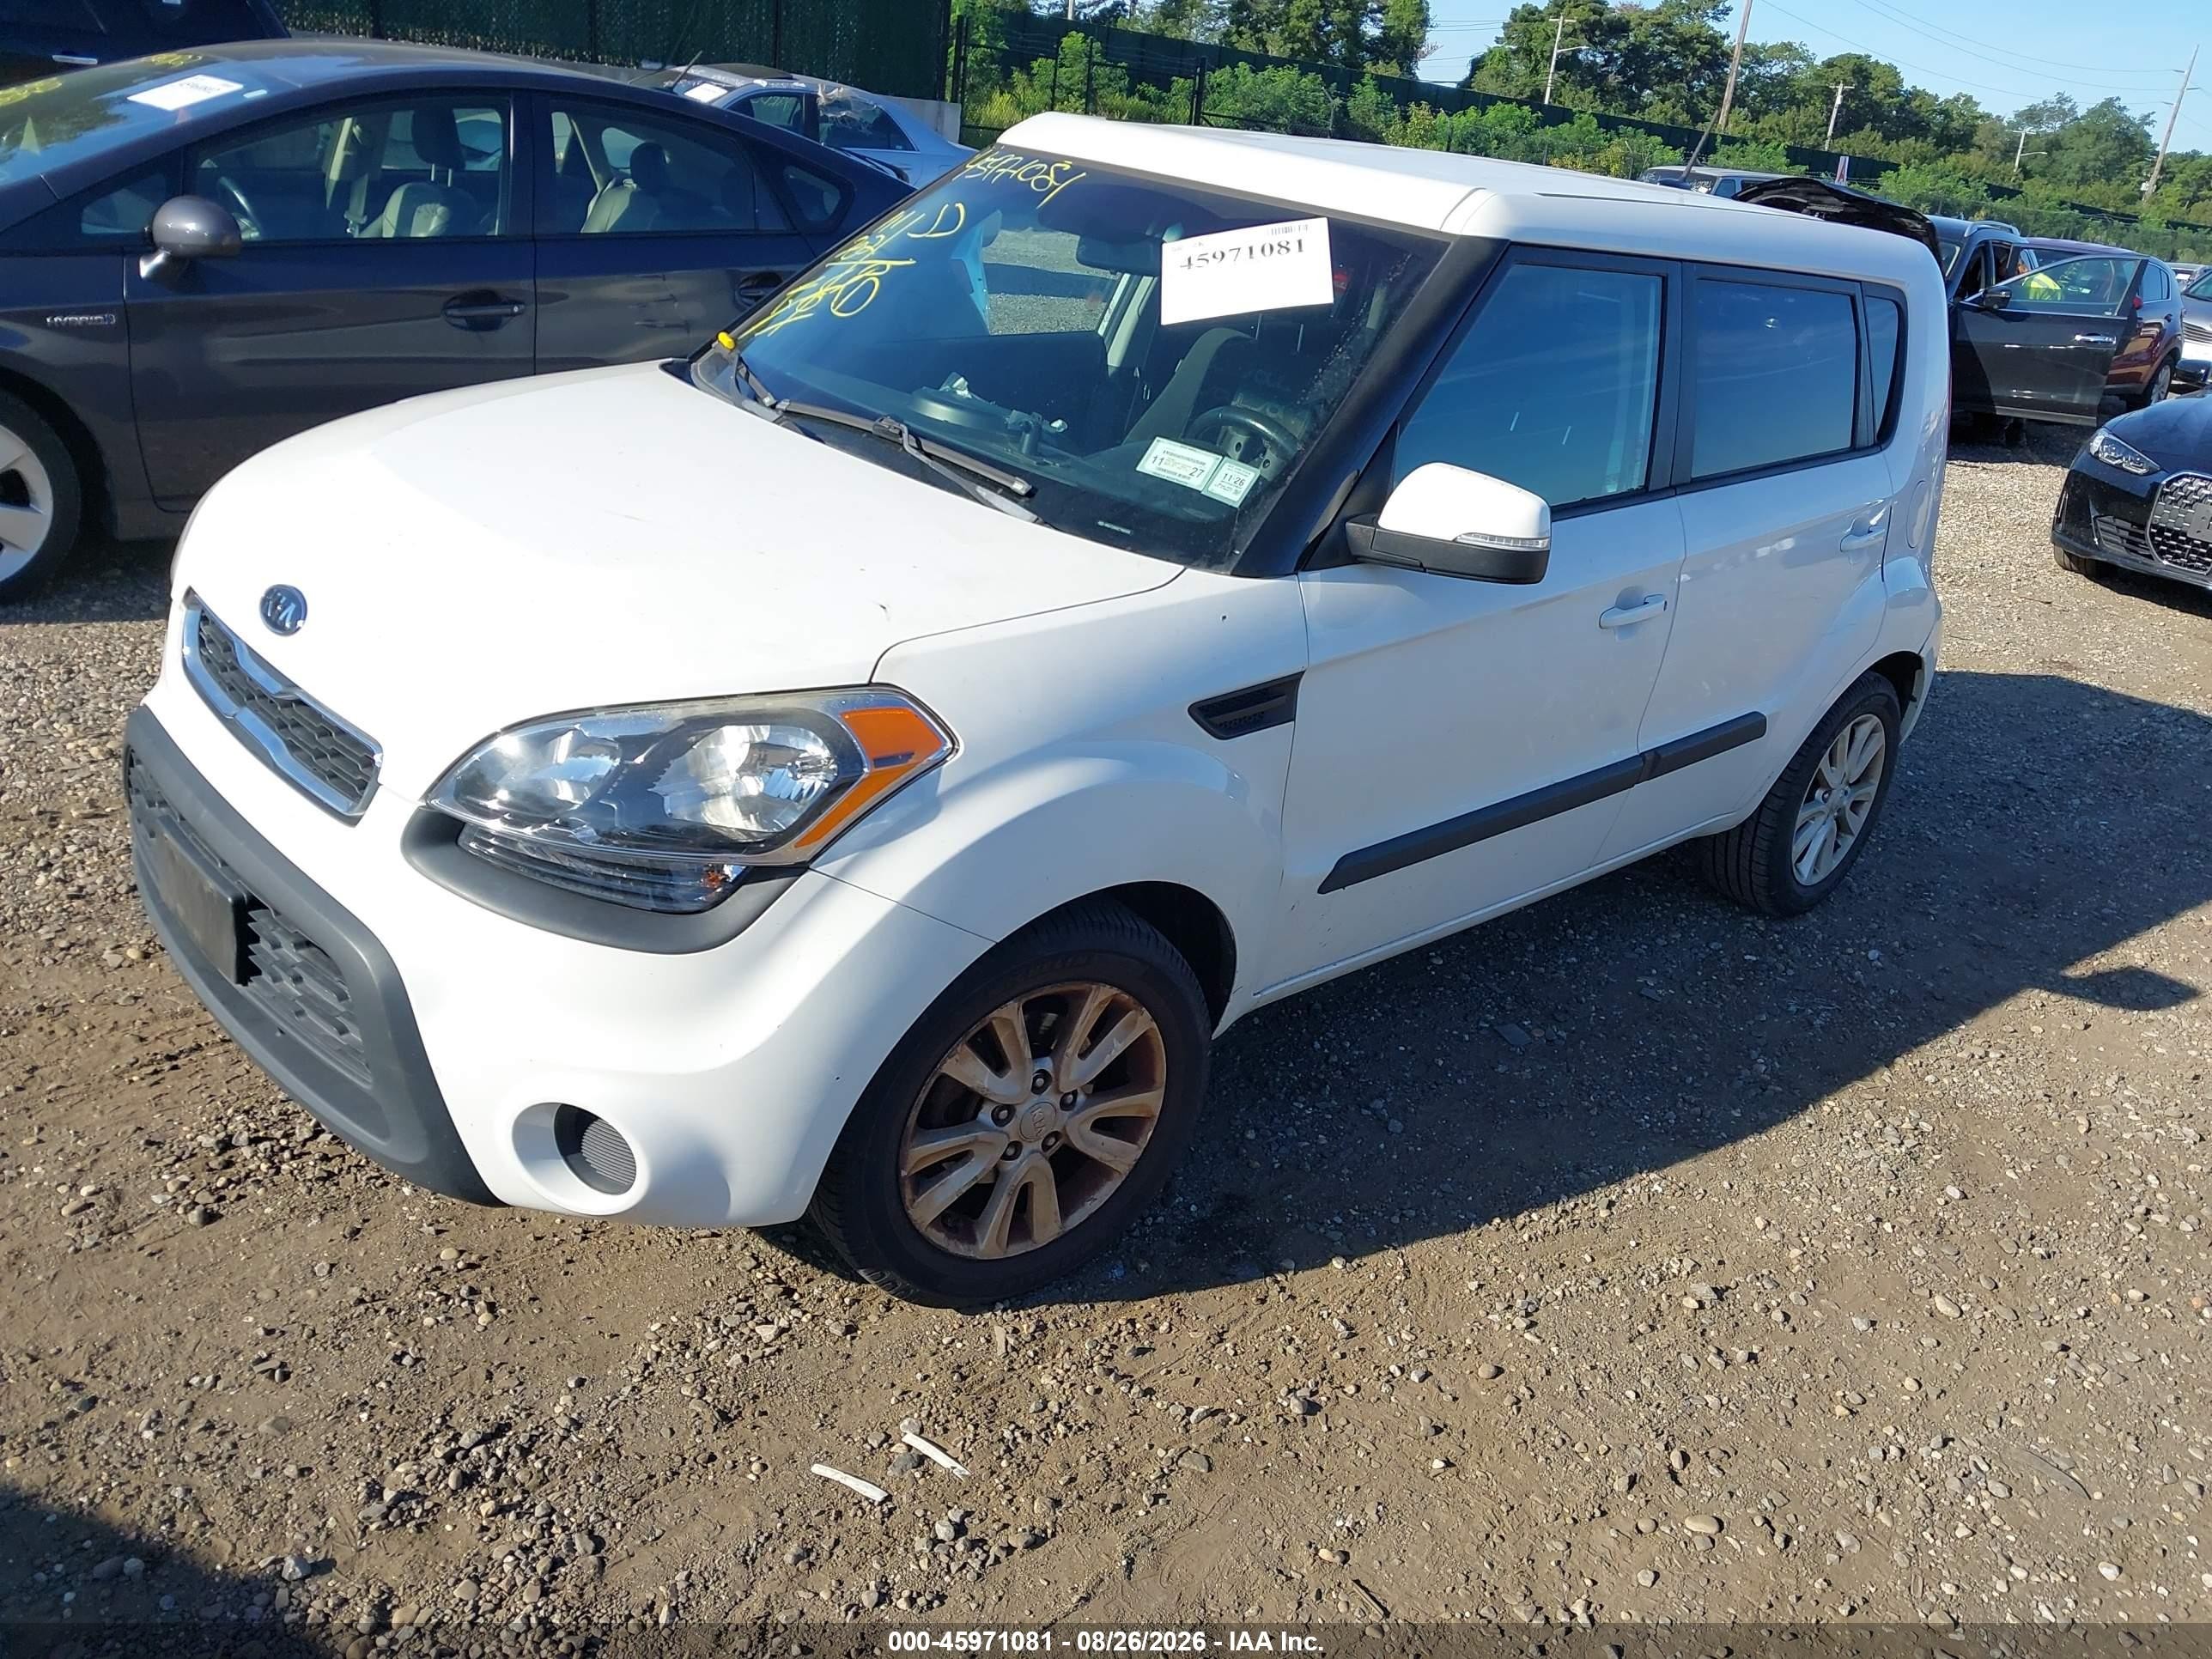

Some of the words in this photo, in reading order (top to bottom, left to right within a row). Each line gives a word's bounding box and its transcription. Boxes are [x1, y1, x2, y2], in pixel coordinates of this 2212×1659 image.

[1179, 238, 1305, 270] 45971081
[1188, 466, 1205, 478] 27
[1030, 1106, 1046, 1138] KIA
